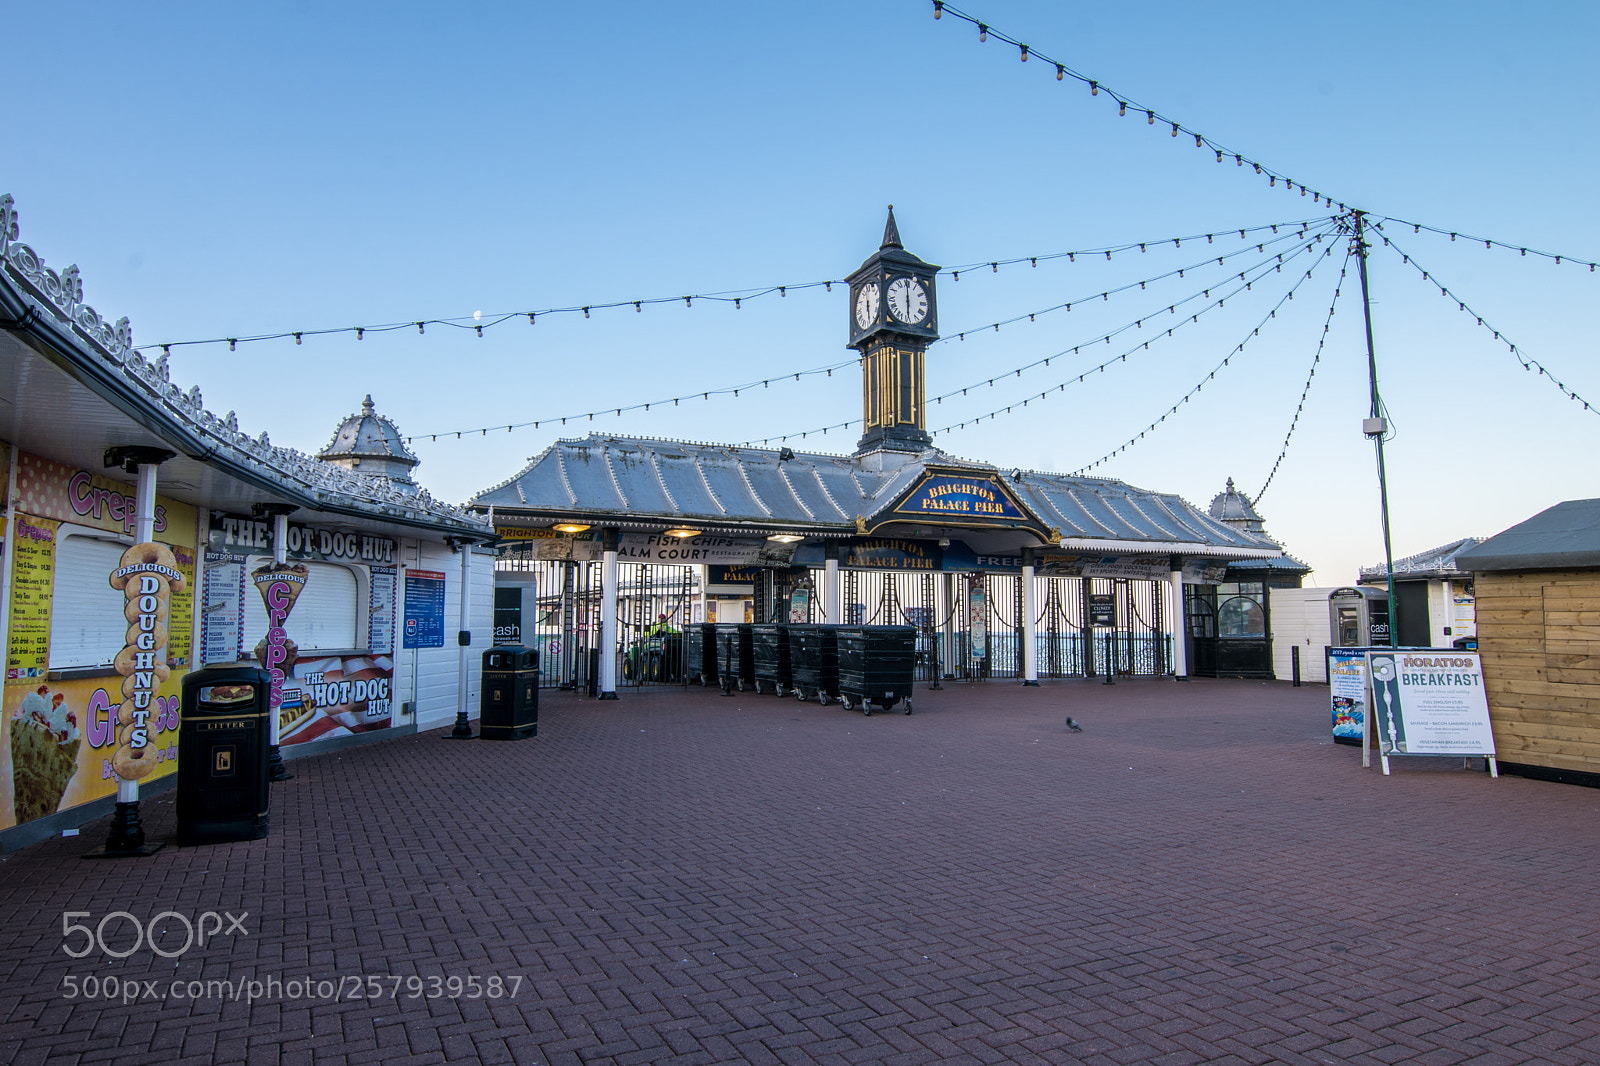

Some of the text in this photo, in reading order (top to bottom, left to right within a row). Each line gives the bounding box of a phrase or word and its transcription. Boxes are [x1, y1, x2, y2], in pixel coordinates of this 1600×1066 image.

[928, 484, 996, 502] BRIGHTON
[68, 470, 168, 533] Creps
[922, 498, 1004, 514] PALACE PIER
[17, 518, 53, 544] Crepes
[500, 528, 554, 539] BRIGHTON
[222, 516, 394, 563] THE OT DOG HUT
[647, 535, 680, 547] FISH
[691, 537, 734, 547] CHIPS
[618, 546, 651, 559] ALM
[658, 549, 709, 560] COURT
[855, 540, 925, 558] BRIGHTON
[848, 555, 934, 569] PALACE PIER
[117, 563, 181, 581] DELICIOUS
[256, 573, 305, 585] DELICIOUS
[723, 572, 755, 581] PALA
[1370, 622, 1389, 633] cash
[265, 582, 291, 708] Crepes
[129, 576, 161, 749] DOUGHNUTS
[1403, 657, 1474, 668] HORATIOS
[305, 672, 325, 685] THE
[1331, 668, 1361, 676] PALACE
[1402, 673, 1479, 686] BREAKFAST
[314, 678, 389, 707] HOT DOG
[367, 698, 391, 716] HUT
[86, 688, 180, 749] Cres
[207, 721, 245, 730] LITTER
